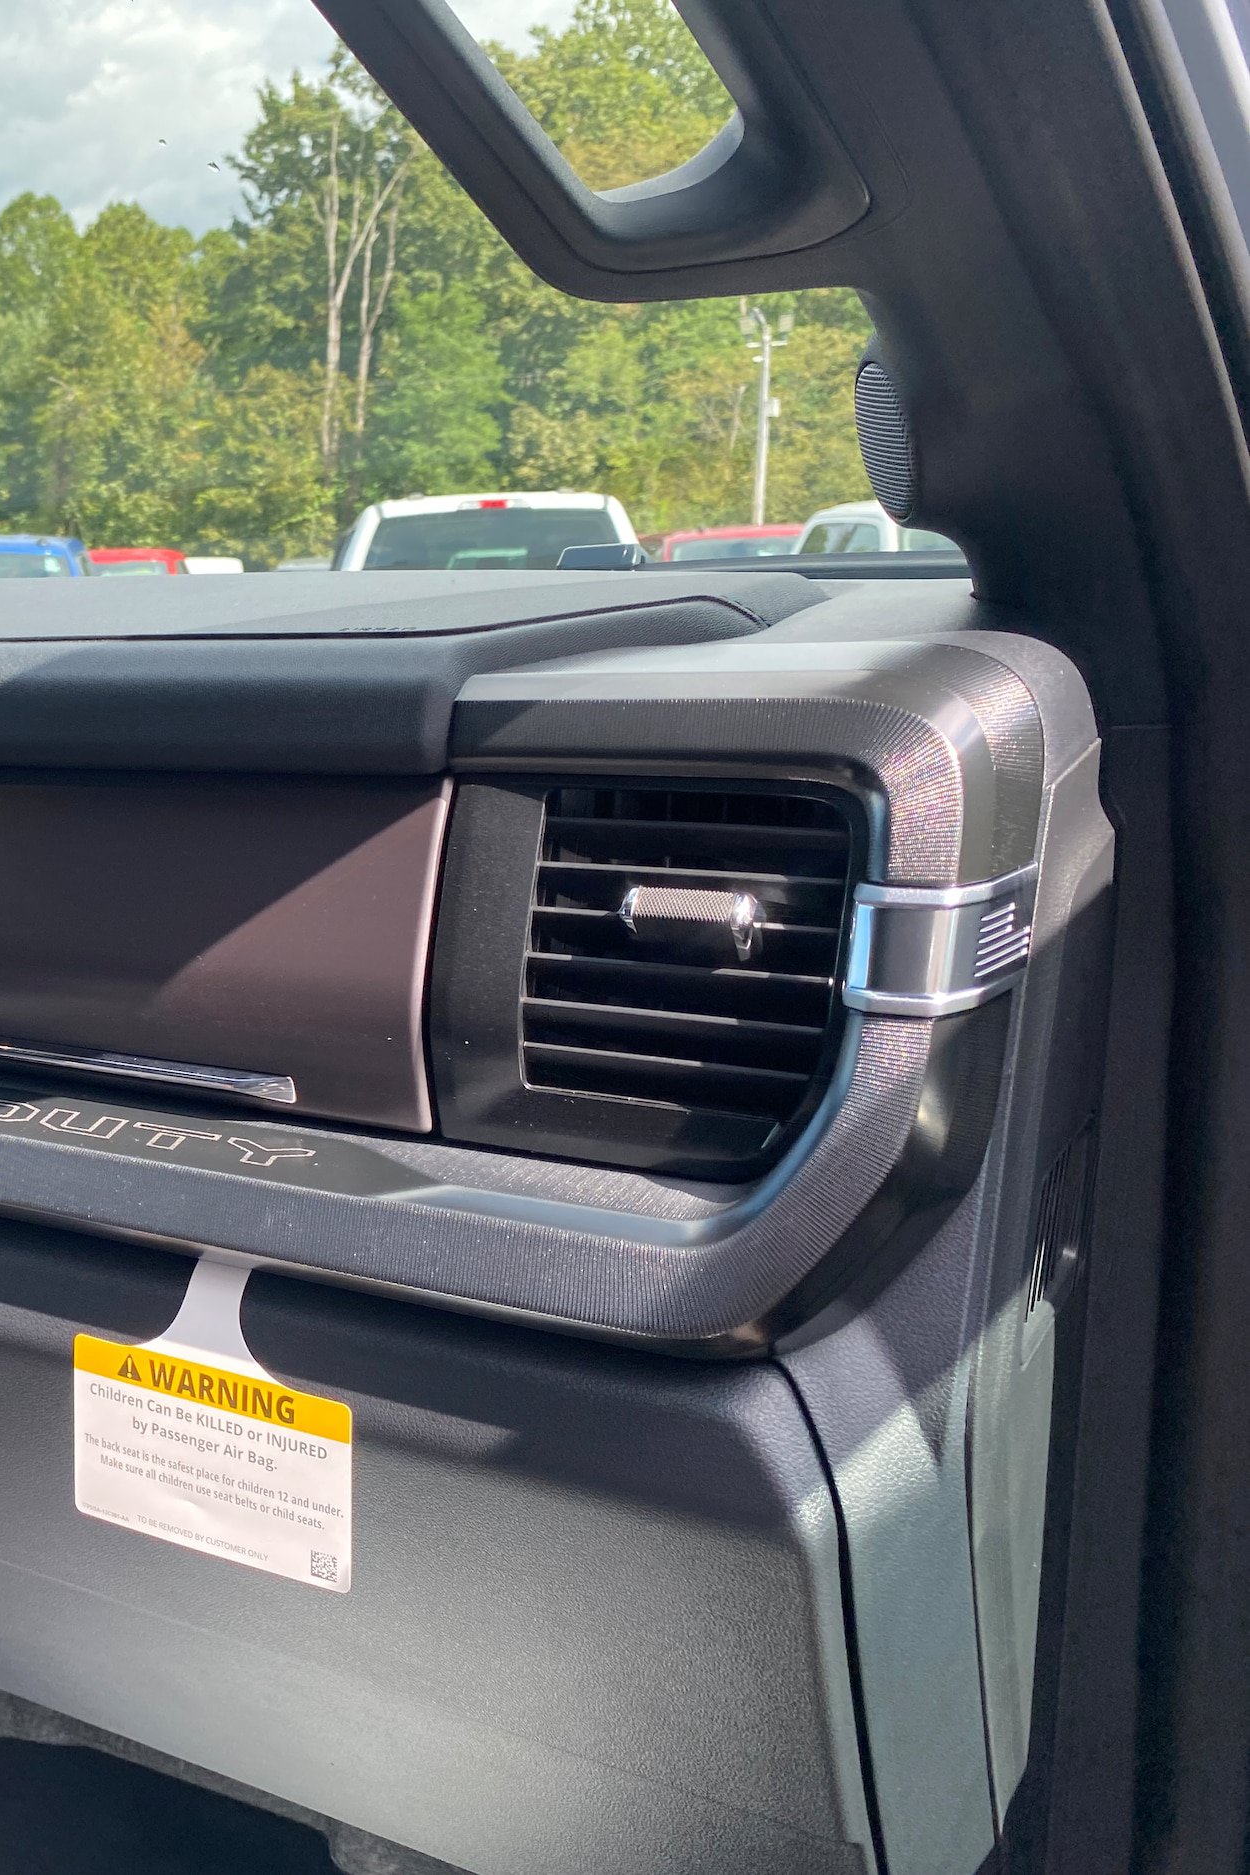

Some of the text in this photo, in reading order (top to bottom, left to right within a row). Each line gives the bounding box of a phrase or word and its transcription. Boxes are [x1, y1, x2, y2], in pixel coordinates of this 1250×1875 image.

[90, 1382, 328, 1460] Children Can Be KILLED or INJURED
[148, 1358, 295, 1425] WARNING
[84, 1433, 344, 1519] The back seat is the safest place for children 12 and under.
[132, 1416, 278, 1472] by Passenger Air Bag.
[100, 1454, 326, 1531] Make sure all children use seat belts or child seats.
[137, 1514, 270, 1562] TO BE REMOVED BY CUSTOMER ONLY
